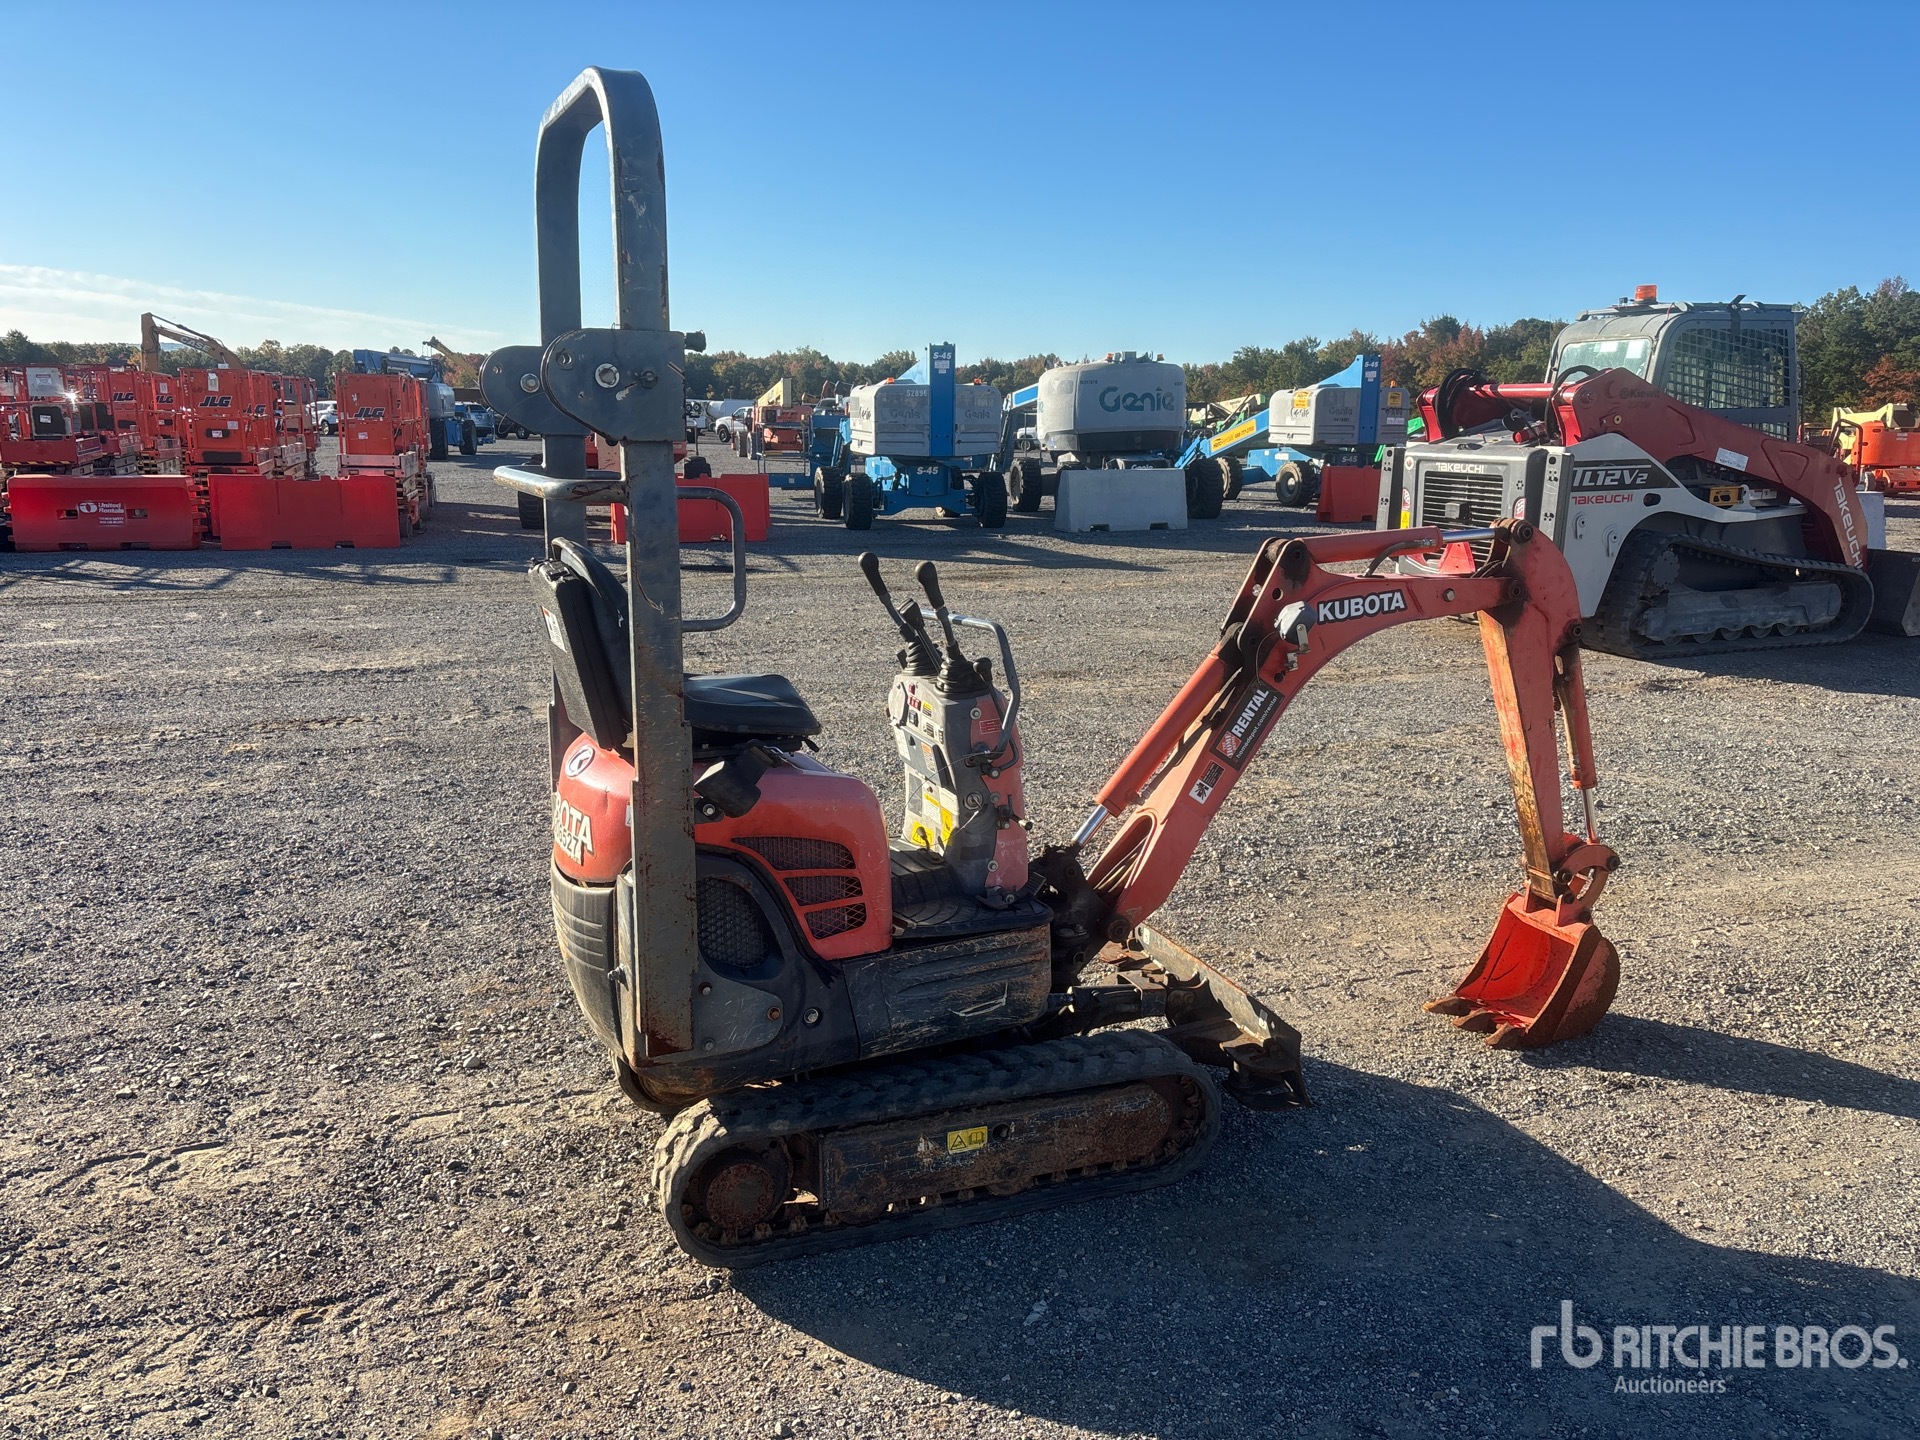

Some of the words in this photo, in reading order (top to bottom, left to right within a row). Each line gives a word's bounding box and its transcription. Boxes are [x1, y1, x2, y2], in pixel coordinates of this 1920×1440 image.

[180, 336, 211, 352] CASE
[932, 351, 952, 360] S-45
[198, 395, 233, 408] JLG
[1099, 385, 1175, 413] Genie
[353, 406, 386, 419] JLG
[964, 409, 991, 420] Genie
[1341, 455, 1358, 463] S-45
[916, 465, 939, 475] S-45
[1318, 591, 1406, 623] KUBOTA
[1231, 689, 1270, 738] RENTAL
[1236, 695, 1279, 759] homedepot.com/rental
